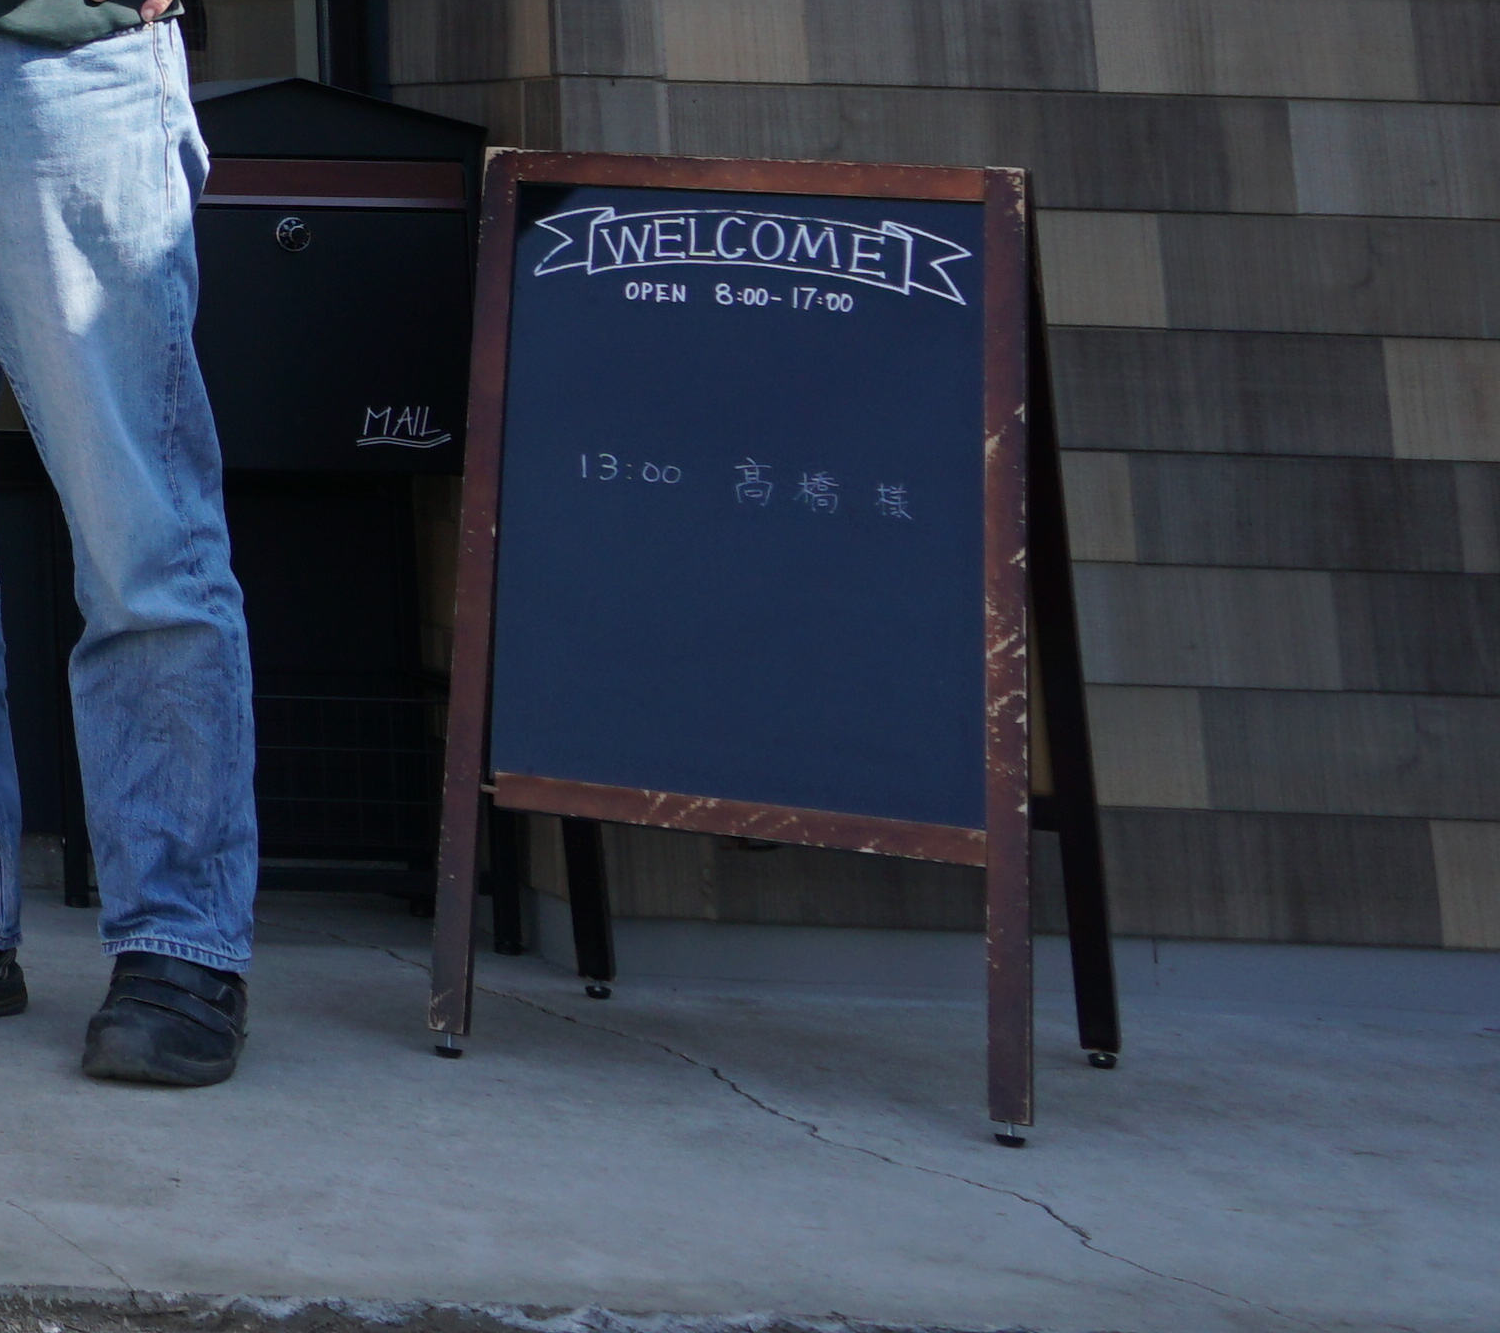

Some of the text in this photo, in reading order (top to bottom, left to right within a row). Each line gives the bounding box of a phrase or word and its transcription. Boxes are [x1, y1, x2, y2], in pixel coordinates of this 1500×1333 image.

[599, 216, 888, 280] WELCOME
[625, 281, 687, 303] OPEN
[362, 405, 441, 437] MAIL
[579, 453, 682, 485] 13:00
